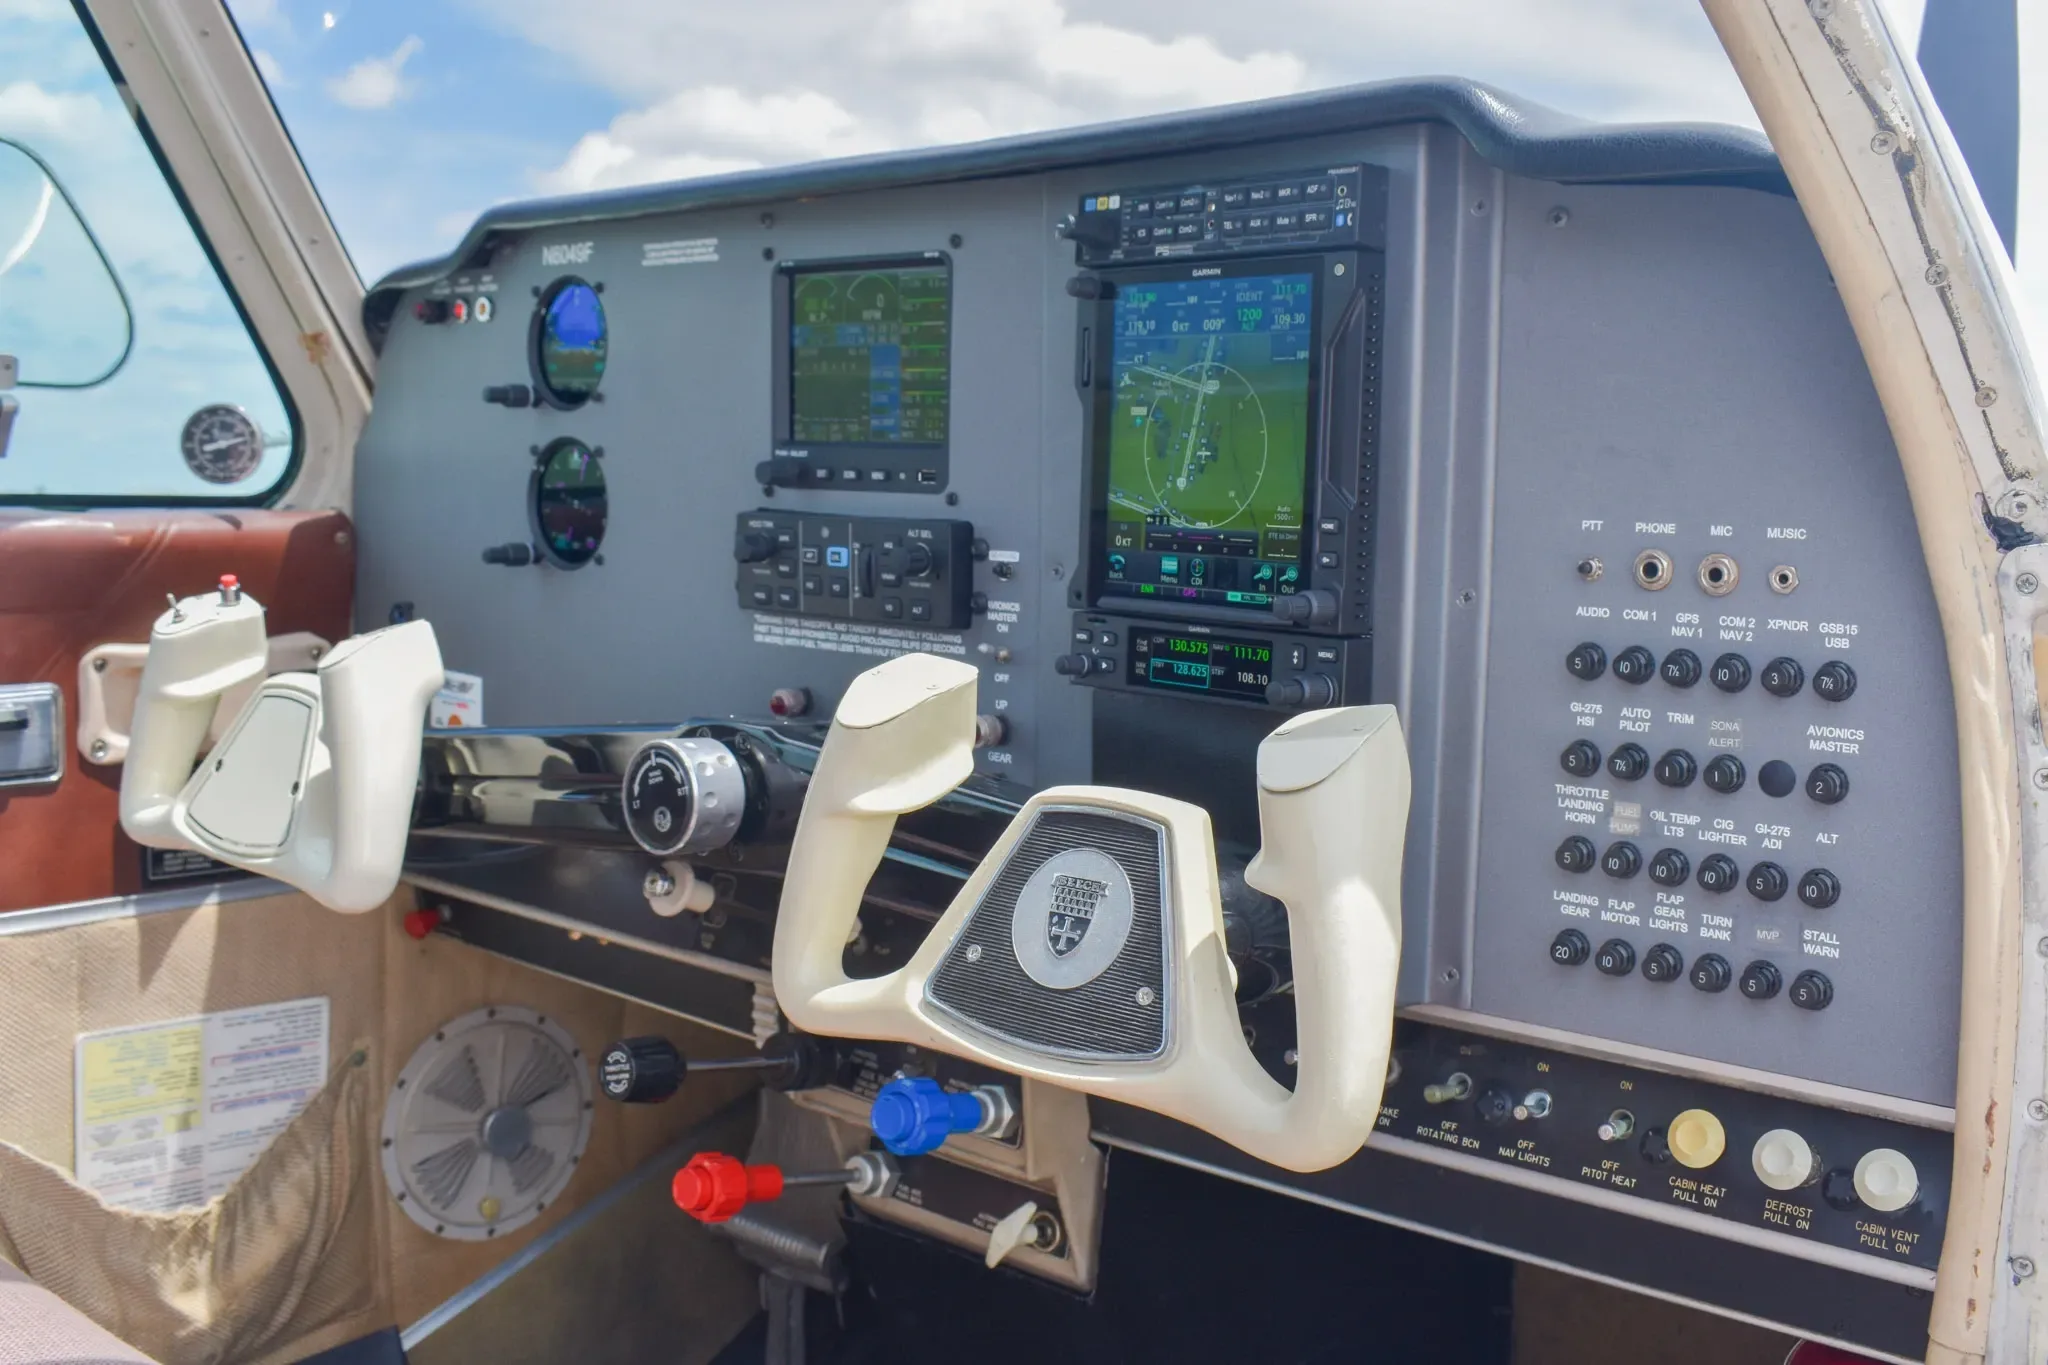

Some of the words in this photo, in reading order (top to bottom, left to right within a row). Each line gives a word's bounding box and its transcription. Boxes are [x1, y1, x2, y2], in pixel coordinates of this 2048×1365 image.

[1307, 185, 1318, 194] ADF
[1192, 268, 1221, 277] GARMIN
[1236, 292, 1262, 302] IDENT
[1237, 308, 1262, 320] 1200
[1582, 520, 1603, 531] PTT
[1636, 522, 1676, 535] PHONE
[1711, 525, 1733, 537] MIC
[908, 529, 919, 538] ALT
[1767, 528, 1806, 539] MUSIC
[1109, 571, 1123, 579] Back
[1161, 575, 1177, 583] Menu
[1191, 577, 1202, 585] CDI
[1281, 585, 1295, 593] Out
[988, 601, 1020, 611] AVIONICS
[1576, 606, 1610, 618] AUDIO
[987, 612, 1018, 622] MASTER
[1623, 610, 1649, 621] COM
[1652, 611, 1656, 621] 1
[1676, 613, 1699, 624] GPS
[1719, 616, 1745, 627] COM
[1748, 618, 1755, 628] 2
[1768, 619, 1808, 632] XPNDR
[997, 624, 1008, 633] ON
[1672, 626, 1694, 637] NAV
[1698, 628, 1703, 638] 1
[1819, 623, 1857, 635] GSB15
[1720, 630, 1743, 641] NAV
[1745, 631, 1753, 641] 2
[1170, 639, 1208, 654] 130.575
[1825, 637, 1850, 649] USB
[1235, 647, 1269, 661] 111.70
[1318, 651, 1333, 660] MENU
[1574, 658, 1581, 669] 5
[1620, 661, 1630, 673] 10
[1173, 663, 1207, 677] 128.625
[1718, 669, 1728, 681] 10
[994, 673, 1010, 683] OFF
[1238, 672, 1268, 685] 108.10
[1771, 673, 1778, 685] 3
[996, 700, 1007, 710] UP
[1570, 703, 1602, 714] GI-275
[1621, 708, 1651, 719] AUTO
[1667, 712, 1694, 725] TRIM
[1577, 716, 1594, 727] HSI
[1620, 720, 1651, 732] PILOT
[1807, 725, 1864, 740] AVIONICS
[1708, 738, 1740, 748] ALERT
[1809, 739, 1859, 754] MASTER
[988, 752, 1012, 764] GEAR
[1569, 756, 1575, 766] 5
[1555, 784, 1609, 800] THROTTLE
[1816, 783, 1823, 794] 2
[1558, 798, 1604, 812] LANDING
[1565, 811, 1596, 824] HORN
[1616, 806, 1638, 817] FUEL
[1650, 810, 1670, 822] OIL
[1672, 813, 1700, 826] TEMP
[1714, 818, 1734, 830] CIG
[1664, 826, 1684, 837] LTS
[1755, 823, 1790, 837] GI-275
[1699, 830, 1747, 846] LIGHTER
[1762, 837, 1782, 849] ADI
[1816, 832, 1838, 844] ALT
[1564, 853, 1570, 864] 5
[1609, 858, 1619, 869] 10
[1656, 865, 1666, 877] 10
[1705, 871, 1715, 883] 10
[1058, 875, 1101, 891] BEECH
[1756, 878, 1763, 889] 5
[1806, 886, 1817, 897] 10
[1553, 891, 1599, 906] LANDING
[1657, 893, 1684, 905] FLAP
[1561, 905, 1590, 918] GEAR
[1608, 899, 1635, 912] FLAP
[1601, 911, 1640, 926] MOTOR
[1654, 906, 1685, 920] GEAR
[1649, 919, 1688, 933] LIGHTS
[1702, 914, 1732, 928] TURN
[1700, 927, 1731, 941] BANK
[1757, 930, 1779, 940] MVP
[1804, 930, 1840, 944] STALL
[1556, 947, 1569, 959] 20
[1803, 943, 1839, 958] WARN
[1602, 956, 1613, 967] 10
[1650, 963, 1657, 974] 5
[1699, 972, 1706, 983] 5
[1749, 980, 1756, 991] 5
[1800, 989, 1807, 1000] 5
[1537, 1063, 1549, 1072] ON
[1620, 1081, 1633, 1090] ON
[1441, 1121, 1457, 1131] OFF
[1417, 1126, 1458, 1144] ROTATING
[1462, 1137, 1480, 1149] BCN
[1517, 1139, 1535, 1150] OFF
[1499, 1147, 1516, 1158] NAV
[1518, 1152, 1550, 1167] LIGHTS
[1602, 1160, 1620, 1171] OFF
[1581, 1167, 1606, 1180] PITOT
[1612, 1174, 1637, 1189] HEAT
[1669, 1176, 1697, 1191] CABIN
[1700, 1184, 1727, 1198] HEAT
[1673, 1190, 1698, 1204] PULL
[1704, 1197, 1718, 1208] ON
[1765, 1199, 1813, 1219] DEFROST
[1763, 1211, 1790, 1226] PULL
[1796, 1219, 1810, 1230] ON
[1856, 1221, 1886, 1237] CABIN
[1891, 1229, 1920, 1244] VENT
[1860, 1235, 1888, 1250] PULL
[1895, 1243, 1910, 1255] ON
